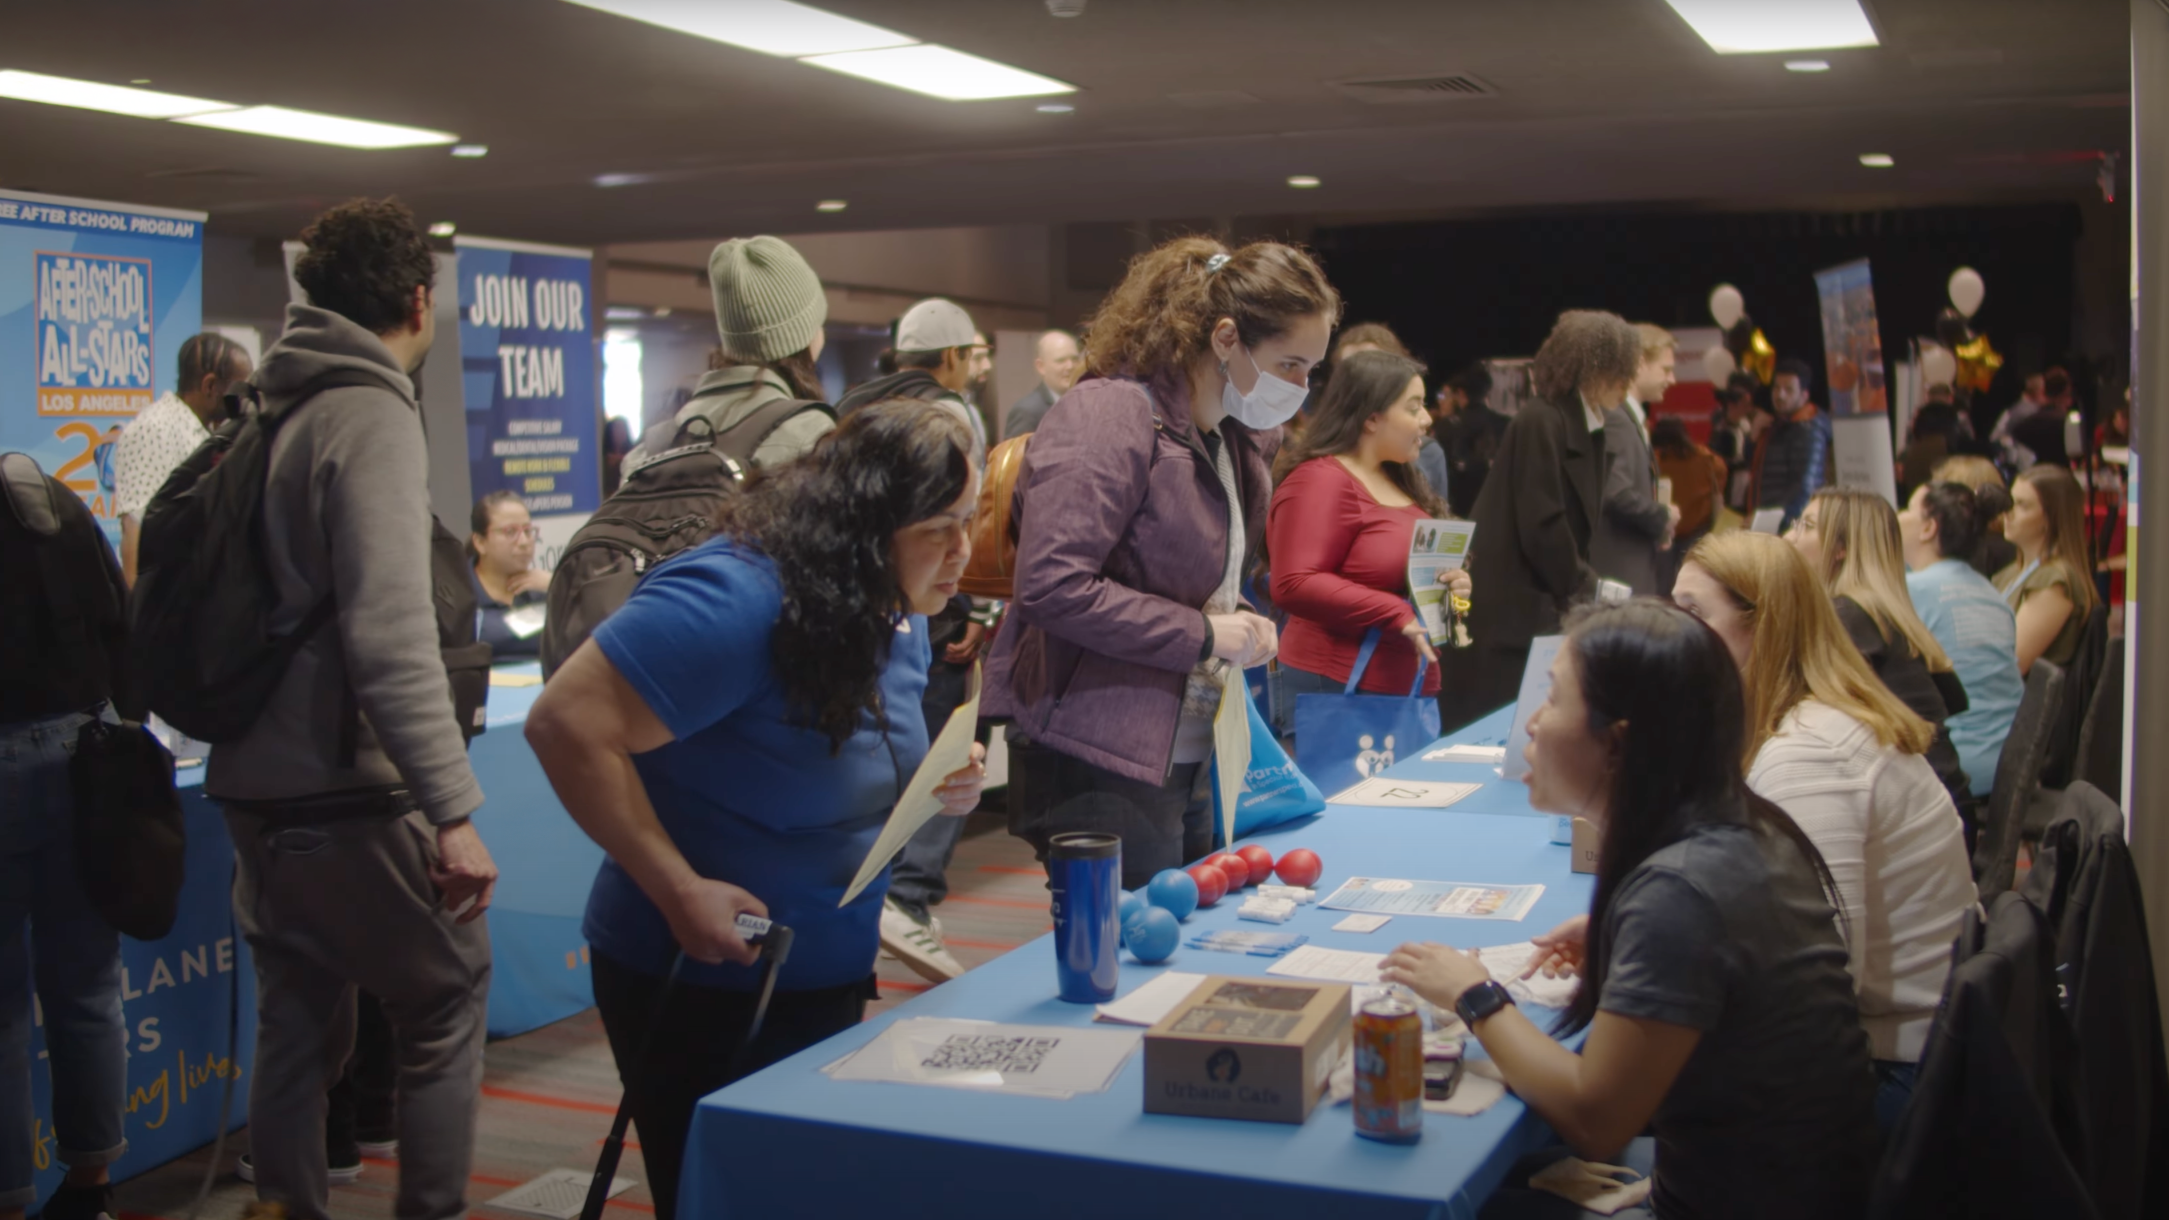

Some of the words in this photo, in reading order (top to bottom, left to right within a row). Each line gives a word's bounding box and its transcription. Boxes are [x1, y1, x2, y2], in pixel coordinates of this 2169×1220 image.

[0, 203, 18, 218] REE
[20, 204, 66, 224] AFTER
[69, 211, 127, 231] SCHOOL
[130, 218, 194, 238] PROGRAM
[469, 274, 530, 329] JOIN
[534, 278, 584, 331] OUR
[41, 320, 149, 387] ALL-STARS
[499, 346, 564, 398] TEAM
[42, 395, 74, 410] LOS
[121, 937, 234, 1001] LANE
[1164, 1081, 1232, 1101] Urbane
[1238, 1085, 1283, 1106] Cafe
